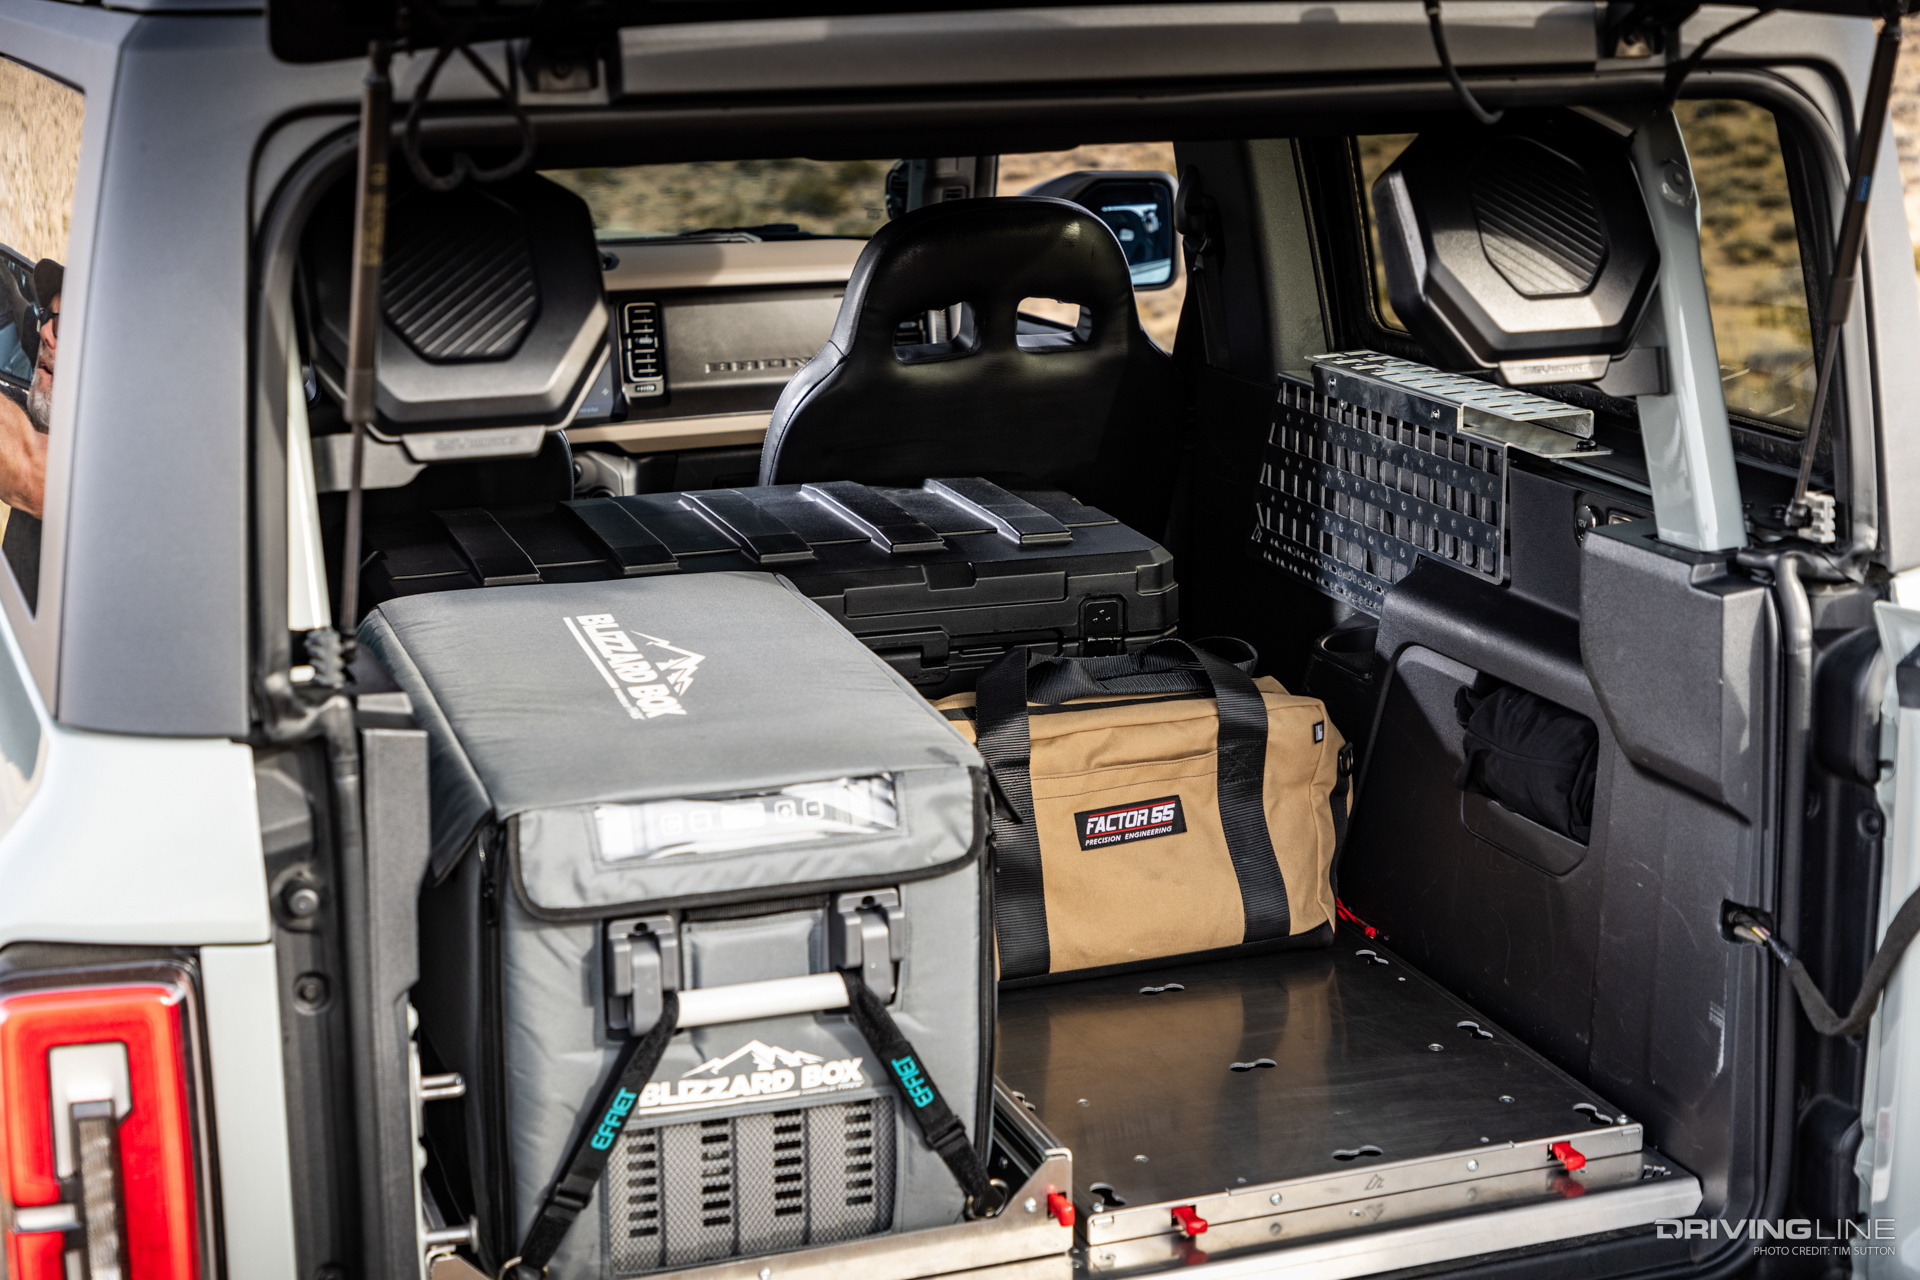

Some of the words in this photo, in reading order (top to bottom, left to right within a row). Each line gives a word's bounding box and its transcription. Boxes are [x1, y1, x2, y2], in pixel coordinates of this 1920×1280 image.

[576, 613, 659, 683] BLIZZARD
[626, 684, 688, 719] BOX
[1085, 834, 1122, 847] PRECISION
[1124, 825, 1173, 840] ENGINEERING
[1086, 808, 1149, 835] FACTOR
[1151, 803, 1176, 824] 55
[639, 1068, 795, 1107] BLIZZARD
[801, 1057, 863, 1089] BOX
